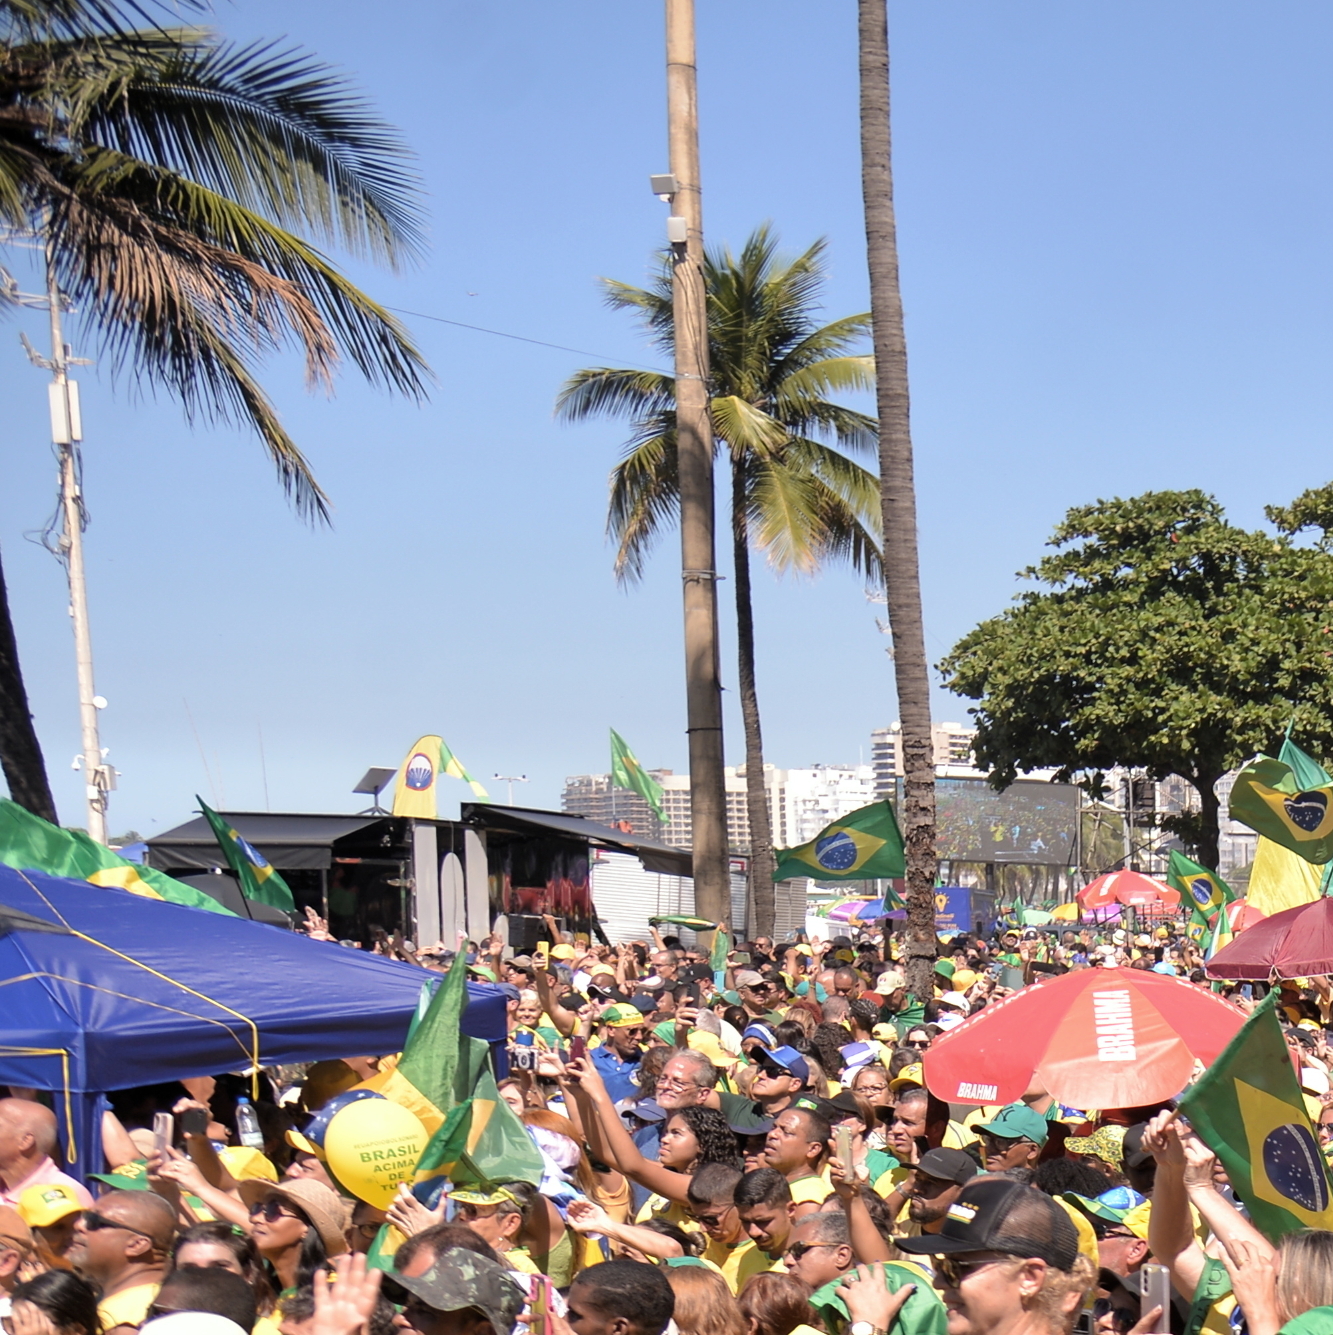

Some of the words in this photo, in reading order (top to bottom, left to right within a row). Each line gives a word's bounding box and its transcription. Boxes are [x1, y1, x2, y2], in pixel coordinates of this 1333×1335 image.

[1093, 989, 1136, 1062] BRAHMA
[957, 1082, 999, 1102] BRAHMA
[359, 1143, 420, 1163] BRASIL
[373, 1158, 416, 1173] ACIMA
[388, 1171, 405, 1181] DE
